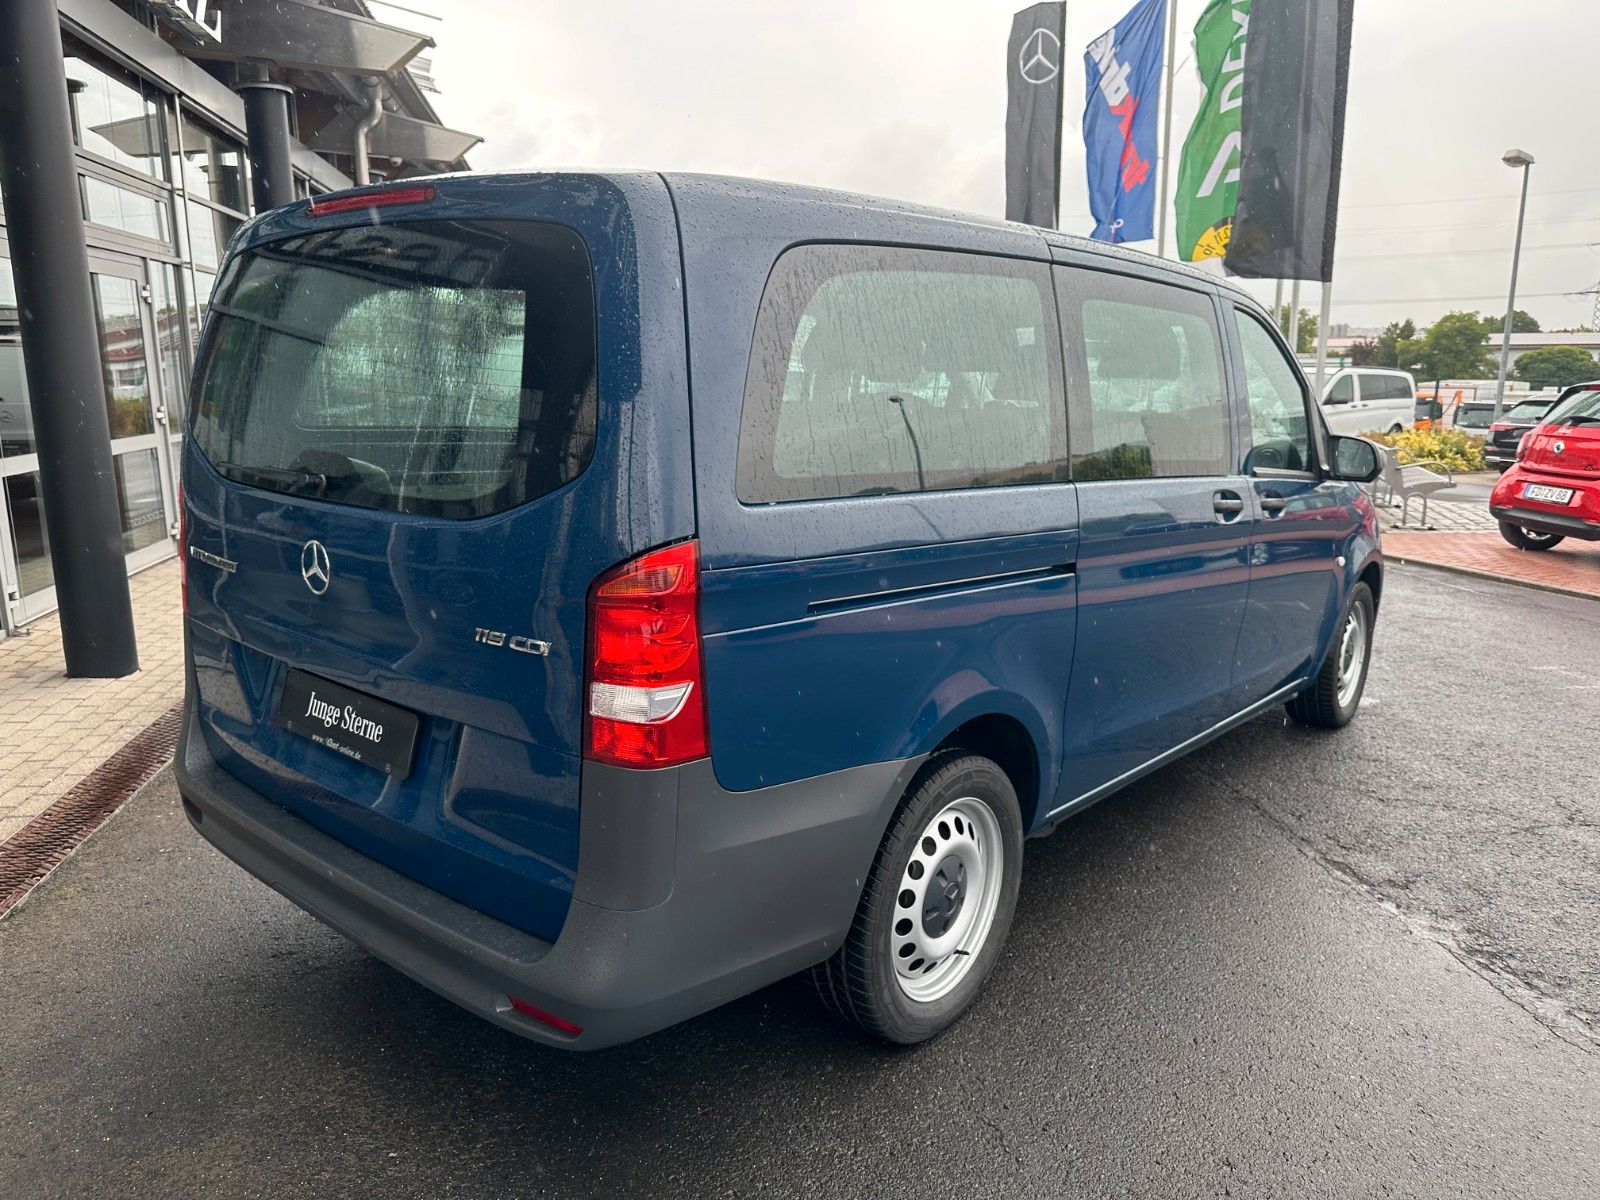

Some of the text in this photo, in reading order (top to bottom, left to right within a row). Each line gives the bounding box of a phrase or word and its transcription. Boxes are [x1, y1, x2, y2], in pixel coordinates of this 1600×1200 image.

[475, 627, 553, 656] 119 CDI
[305, 691, 384, 743] Junge Sterne
